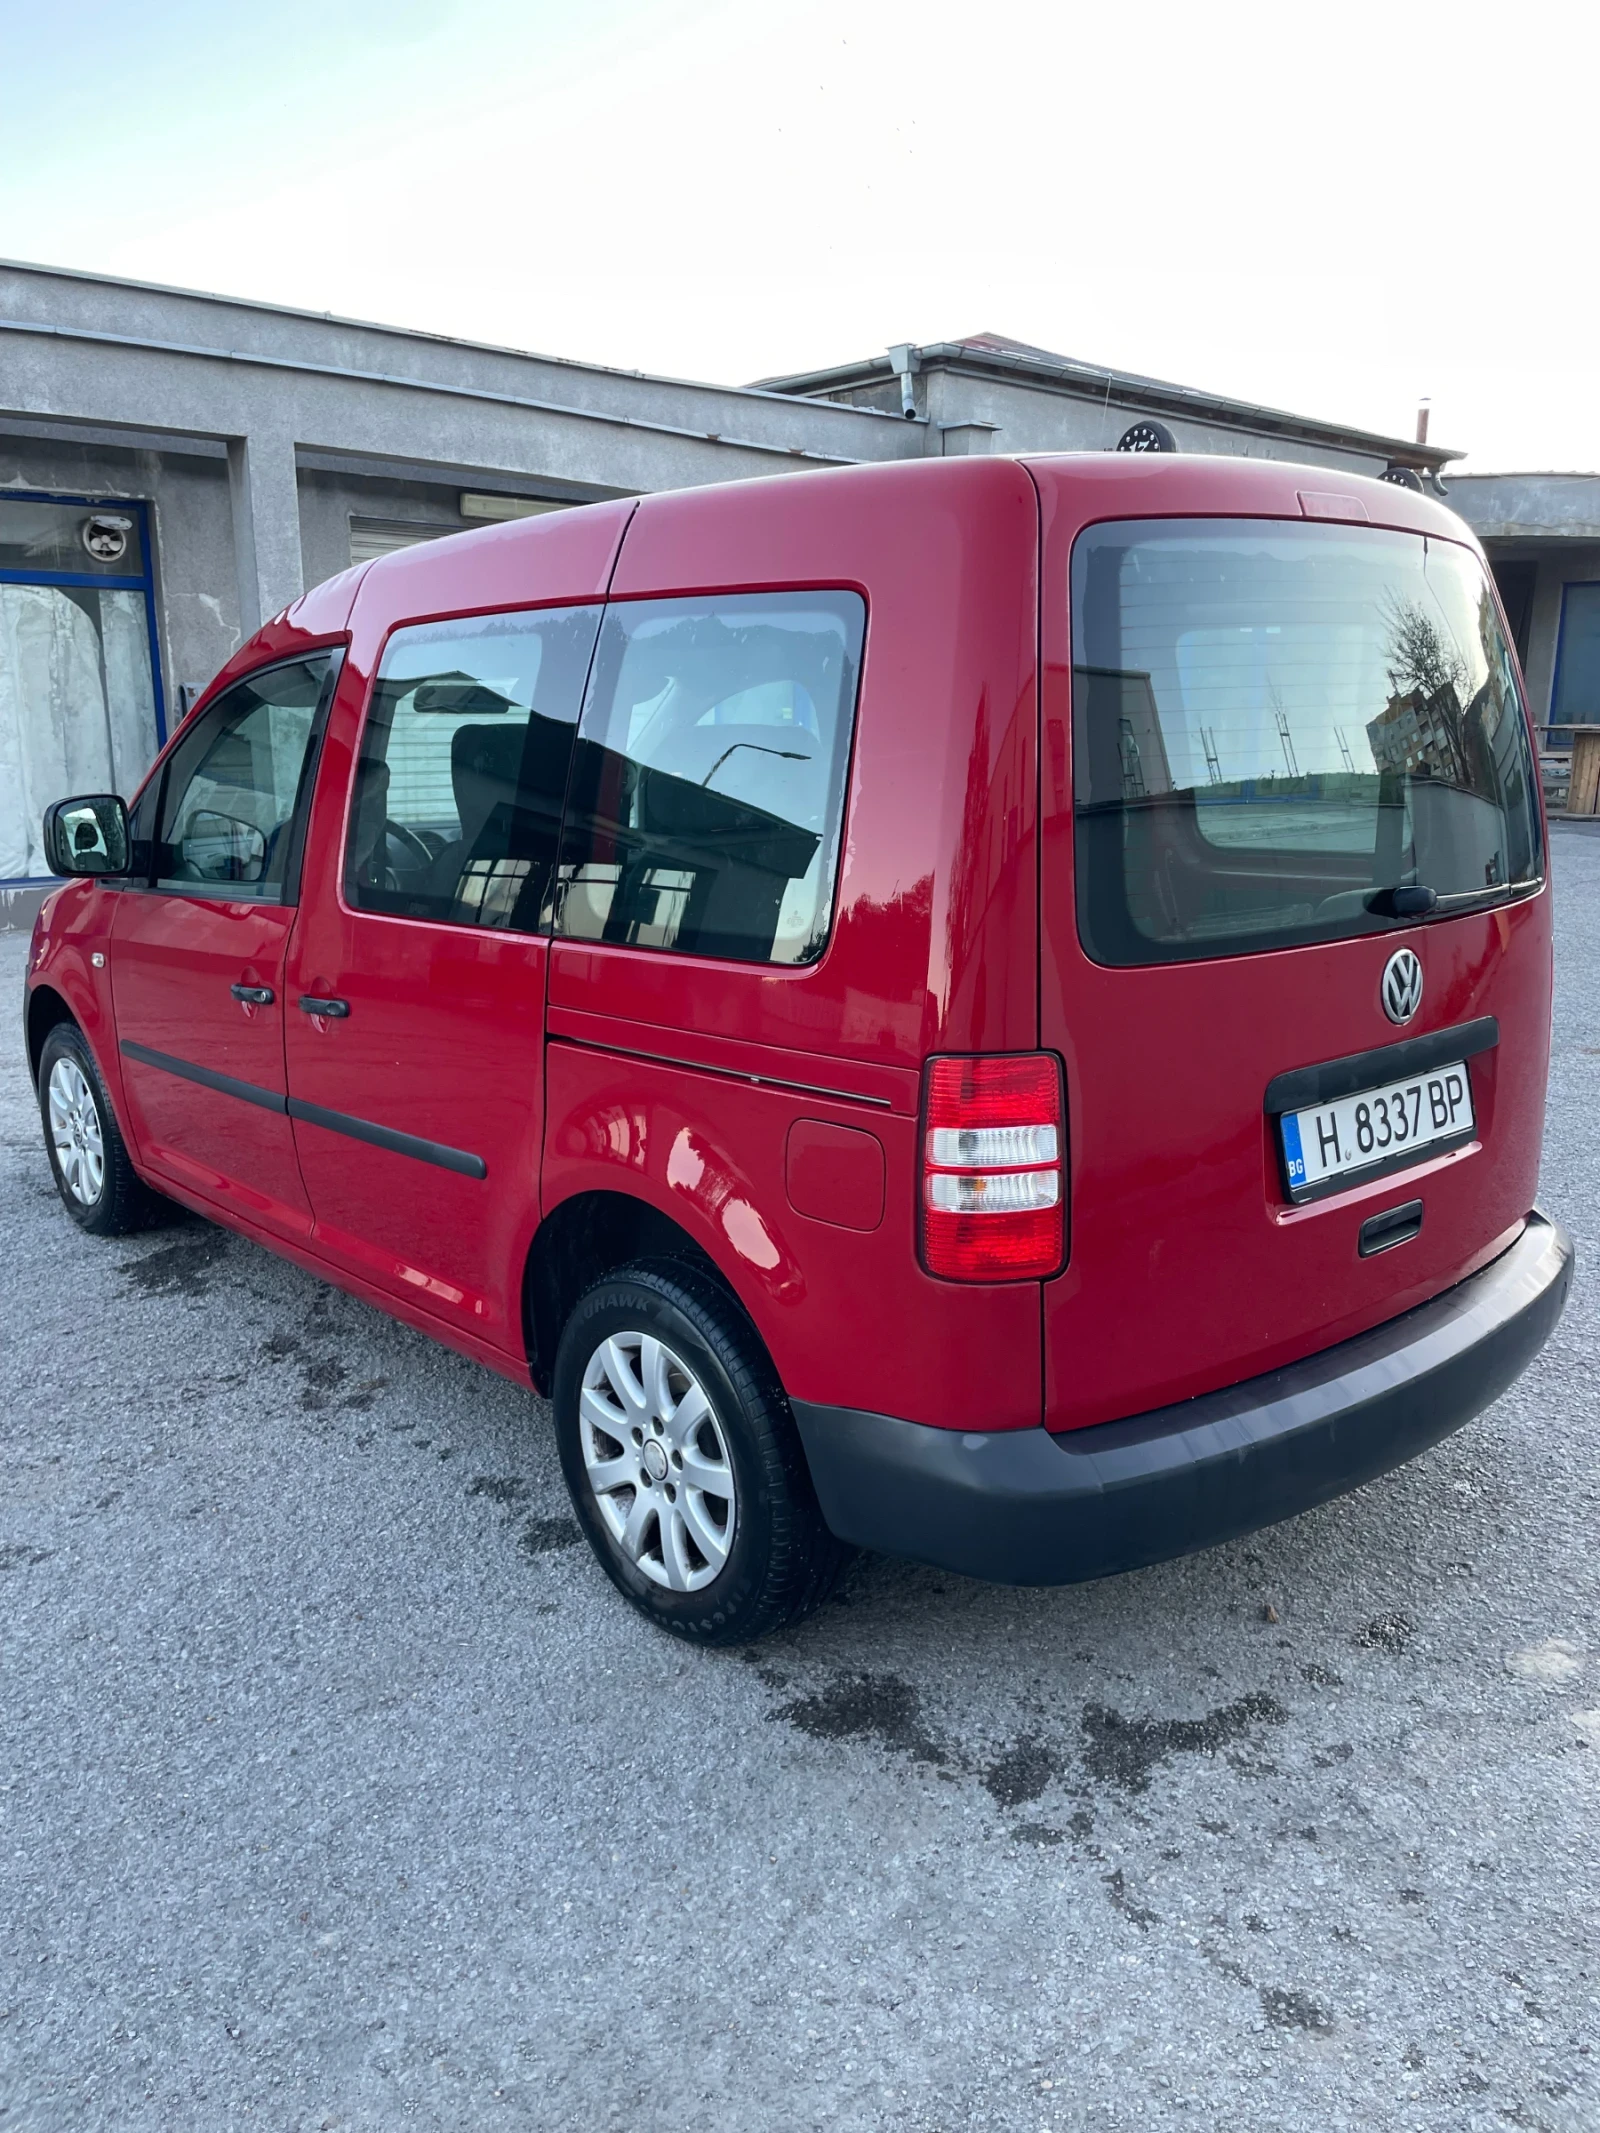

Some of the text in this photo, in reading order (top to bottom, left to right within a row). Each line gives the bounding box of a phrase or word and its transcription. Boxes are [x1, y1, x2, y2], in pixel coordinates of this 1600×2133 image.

[1316, 1074, 1463, 1168] H 8337 BP
[1288, 1158, 1304, 1177] BG
